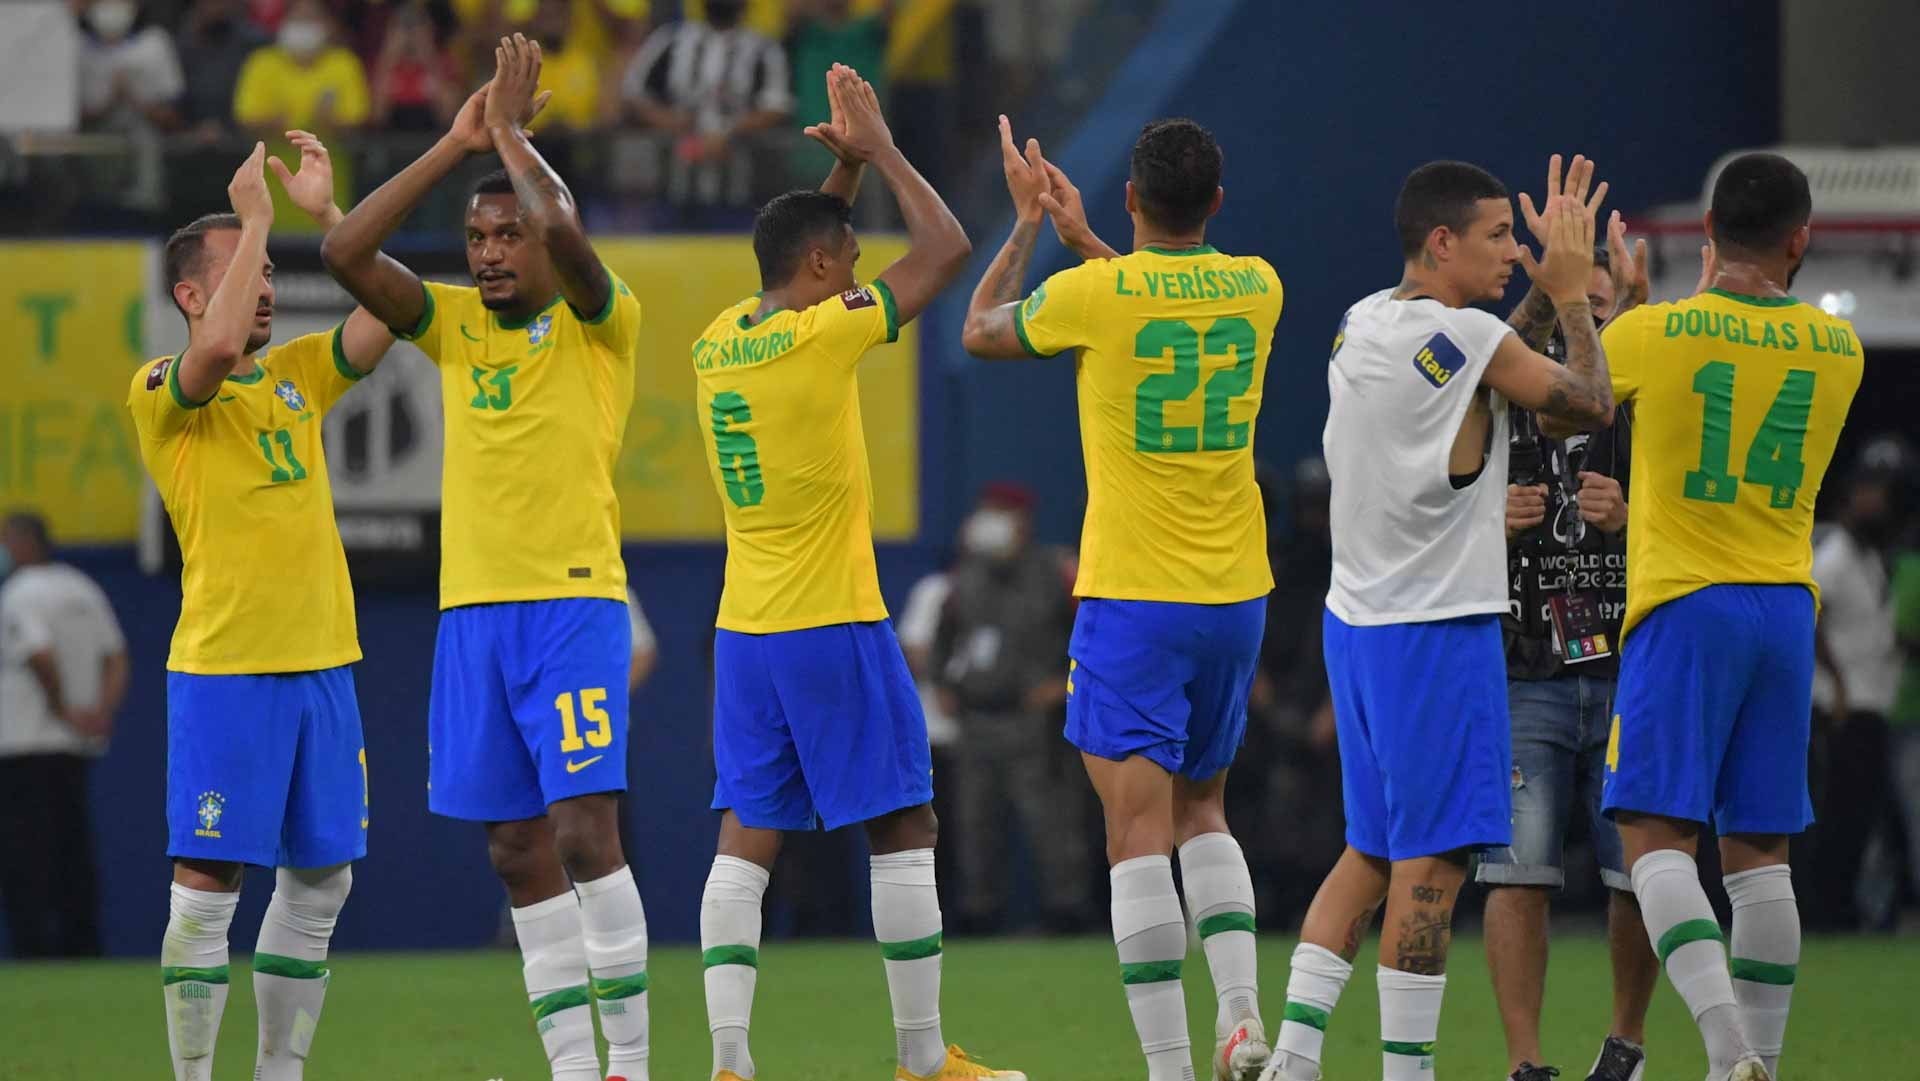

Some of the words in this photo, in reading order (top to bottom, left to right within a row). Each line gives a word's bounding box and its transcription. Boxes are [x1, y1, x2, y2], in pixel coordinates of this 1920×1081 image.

[1664, 309, 1799, 351] DOUGLAS
[1808, 323, 1857, 357] LUIZ
[1134, 316, 1257, 453] 22
[1416, 347, 1450, 384] Itaú
[258, 428, 307, 483] 11
[710, 390, 765, 508] 6
[1683, 360, 1816, 510] 14
[1604, 554, 1626, 569] CU
[1583, 641, 1592, 652] 2
[555, 687, 613, 753] 15
